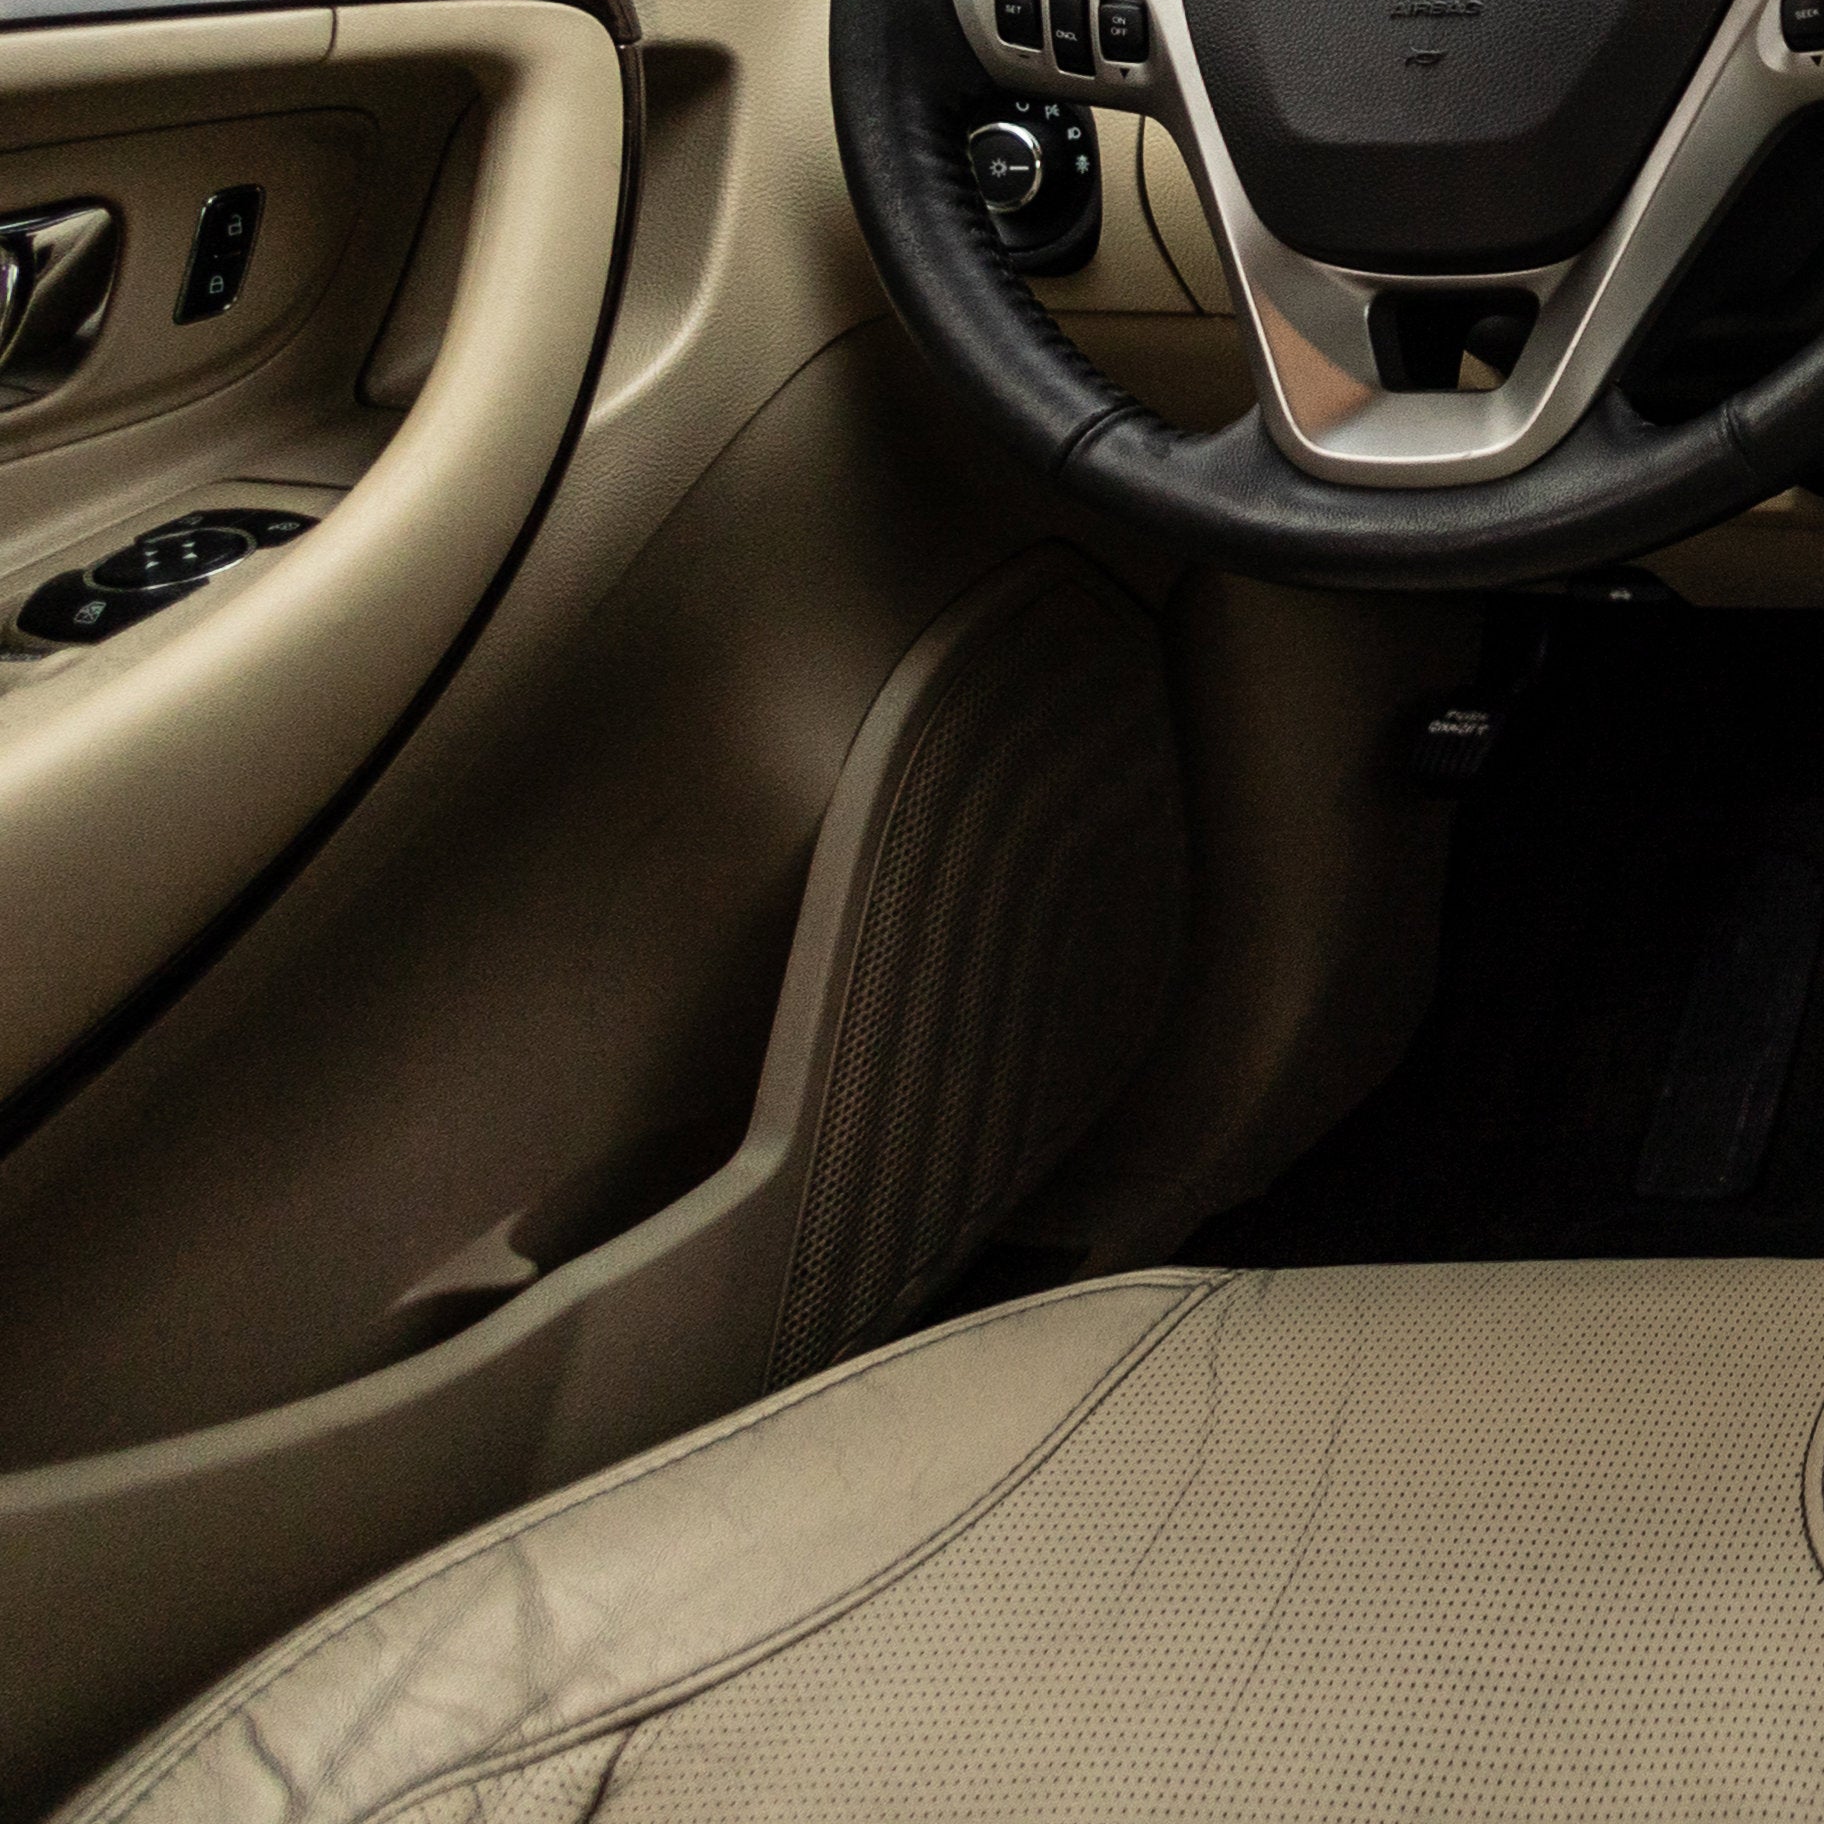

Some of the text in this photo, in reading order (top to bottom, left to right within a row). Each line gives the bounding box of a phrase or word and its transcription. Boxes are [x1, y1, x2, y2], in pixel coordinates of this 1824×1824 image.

[1005, 4, 1022, 15] SET
[1390, 0, 1485, 19] AIRBAG
[1112, 15, 1127, 26] ON
[1055, 29, 1078, 42] CNCL
[1110, 27, 1128, 37] OFF
